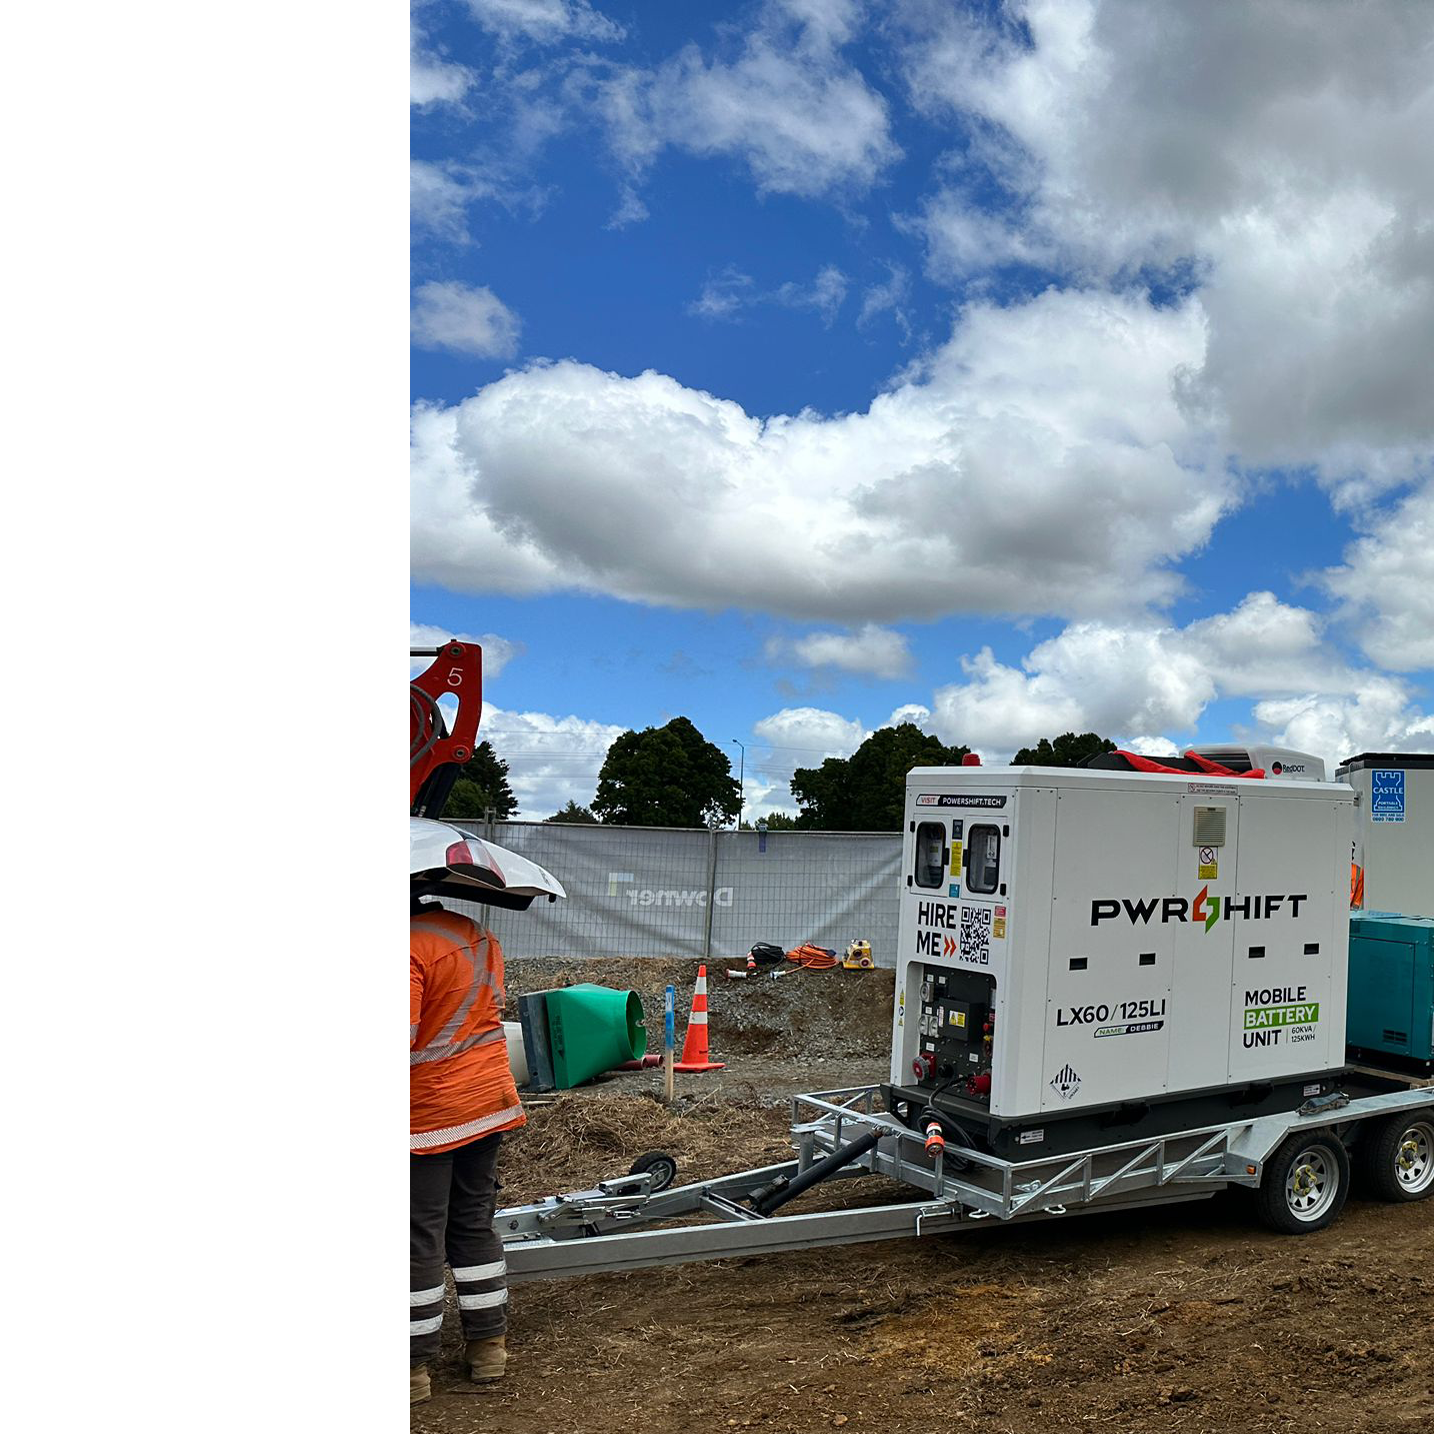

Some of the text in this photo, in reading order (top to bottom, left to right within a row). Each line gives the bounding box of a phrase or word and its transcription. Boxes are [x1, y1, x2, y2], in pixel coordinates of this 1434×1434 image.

[447, 667, 463, 687] 5
[1373, 787, 1404, 795] CASTLE
[942, 797, 1002, 806] POWERSHIFT.TECH
[918, 901, 957, 929] HIRE
[916, 930, 942, 957] ME
[1245, 986, 1306, 1006] MOBILE
[1245, 1006, 1316, 1028] BATTERY
[1130, 1023, 1159, 1032] DEBBIE
[1243, 1029, 1282, 1048] UNIT
[1292, 1034, 1315, 1042] 125KWH
